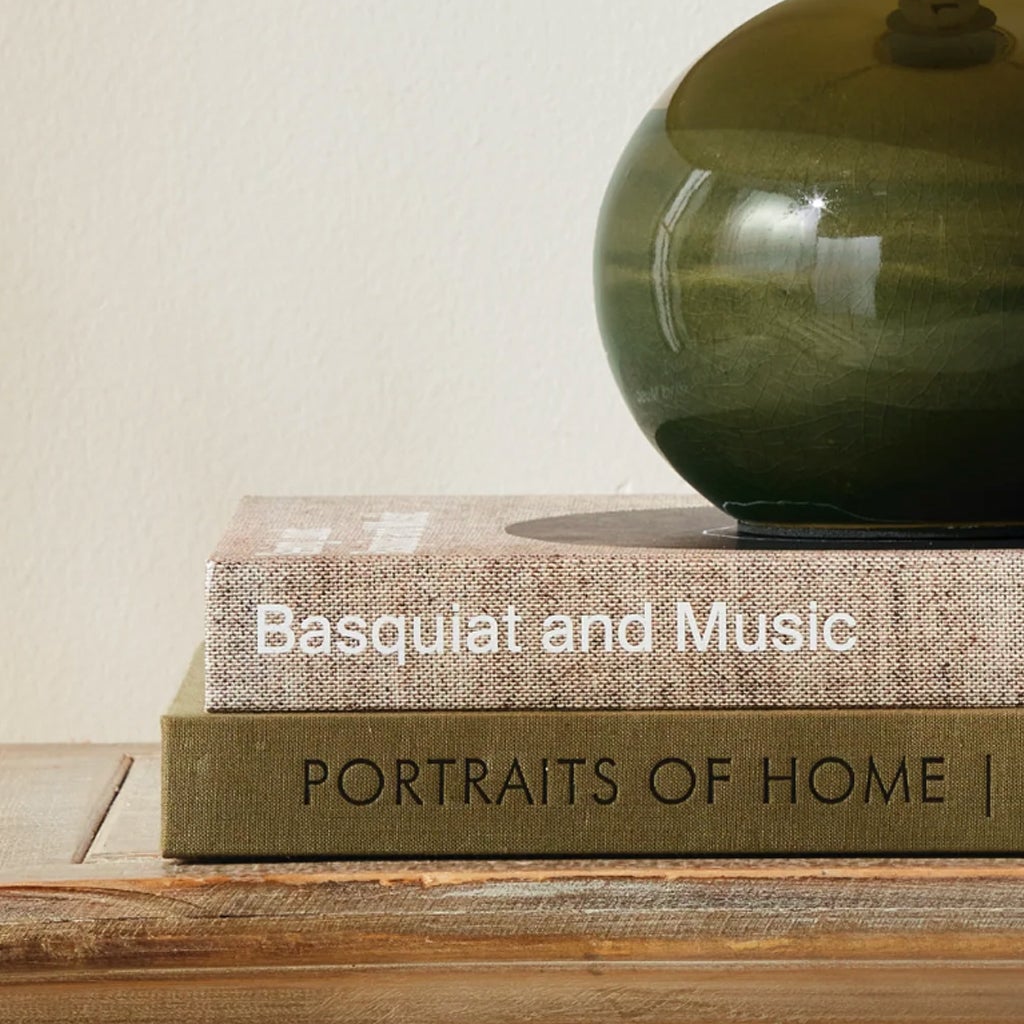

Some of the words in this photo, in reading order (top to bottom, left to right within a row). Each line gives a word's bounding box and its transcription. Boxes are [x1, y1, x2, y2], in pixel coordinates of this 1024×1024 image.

[255, 603, 522, 665] Basquiat
[541, 601, 653, 654] and
[676, 599, 858, 653] Music
[303, 756, 618, 806] PORTRAITS
[648, 756, 733, 805] OF
[762, 755, 946, 804] HOME
